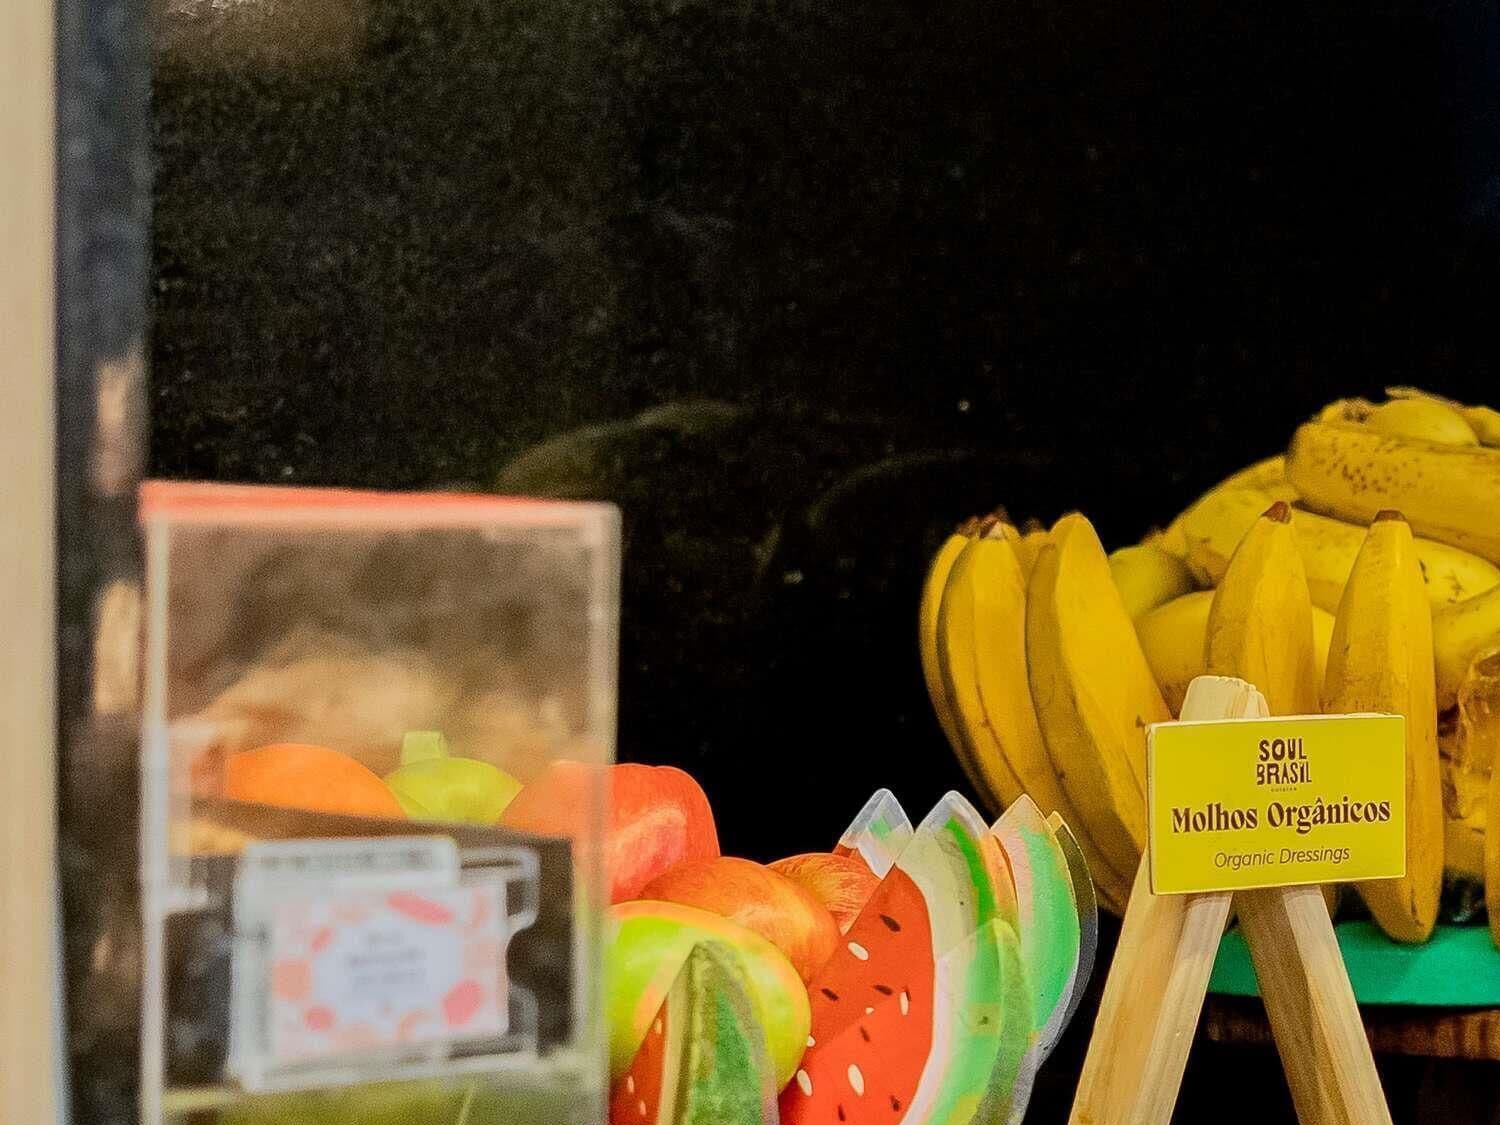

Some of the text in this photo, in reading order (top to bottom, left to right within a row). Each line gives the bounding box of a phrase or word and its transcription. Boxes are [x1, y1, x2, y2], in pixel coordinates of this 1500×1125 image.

[1259, 738, 1307, 761] SOUL
[1172, 796, 1391, 835] Molhos Orgânicos
[1214, 846, 1350, 871] Organic Dressings
